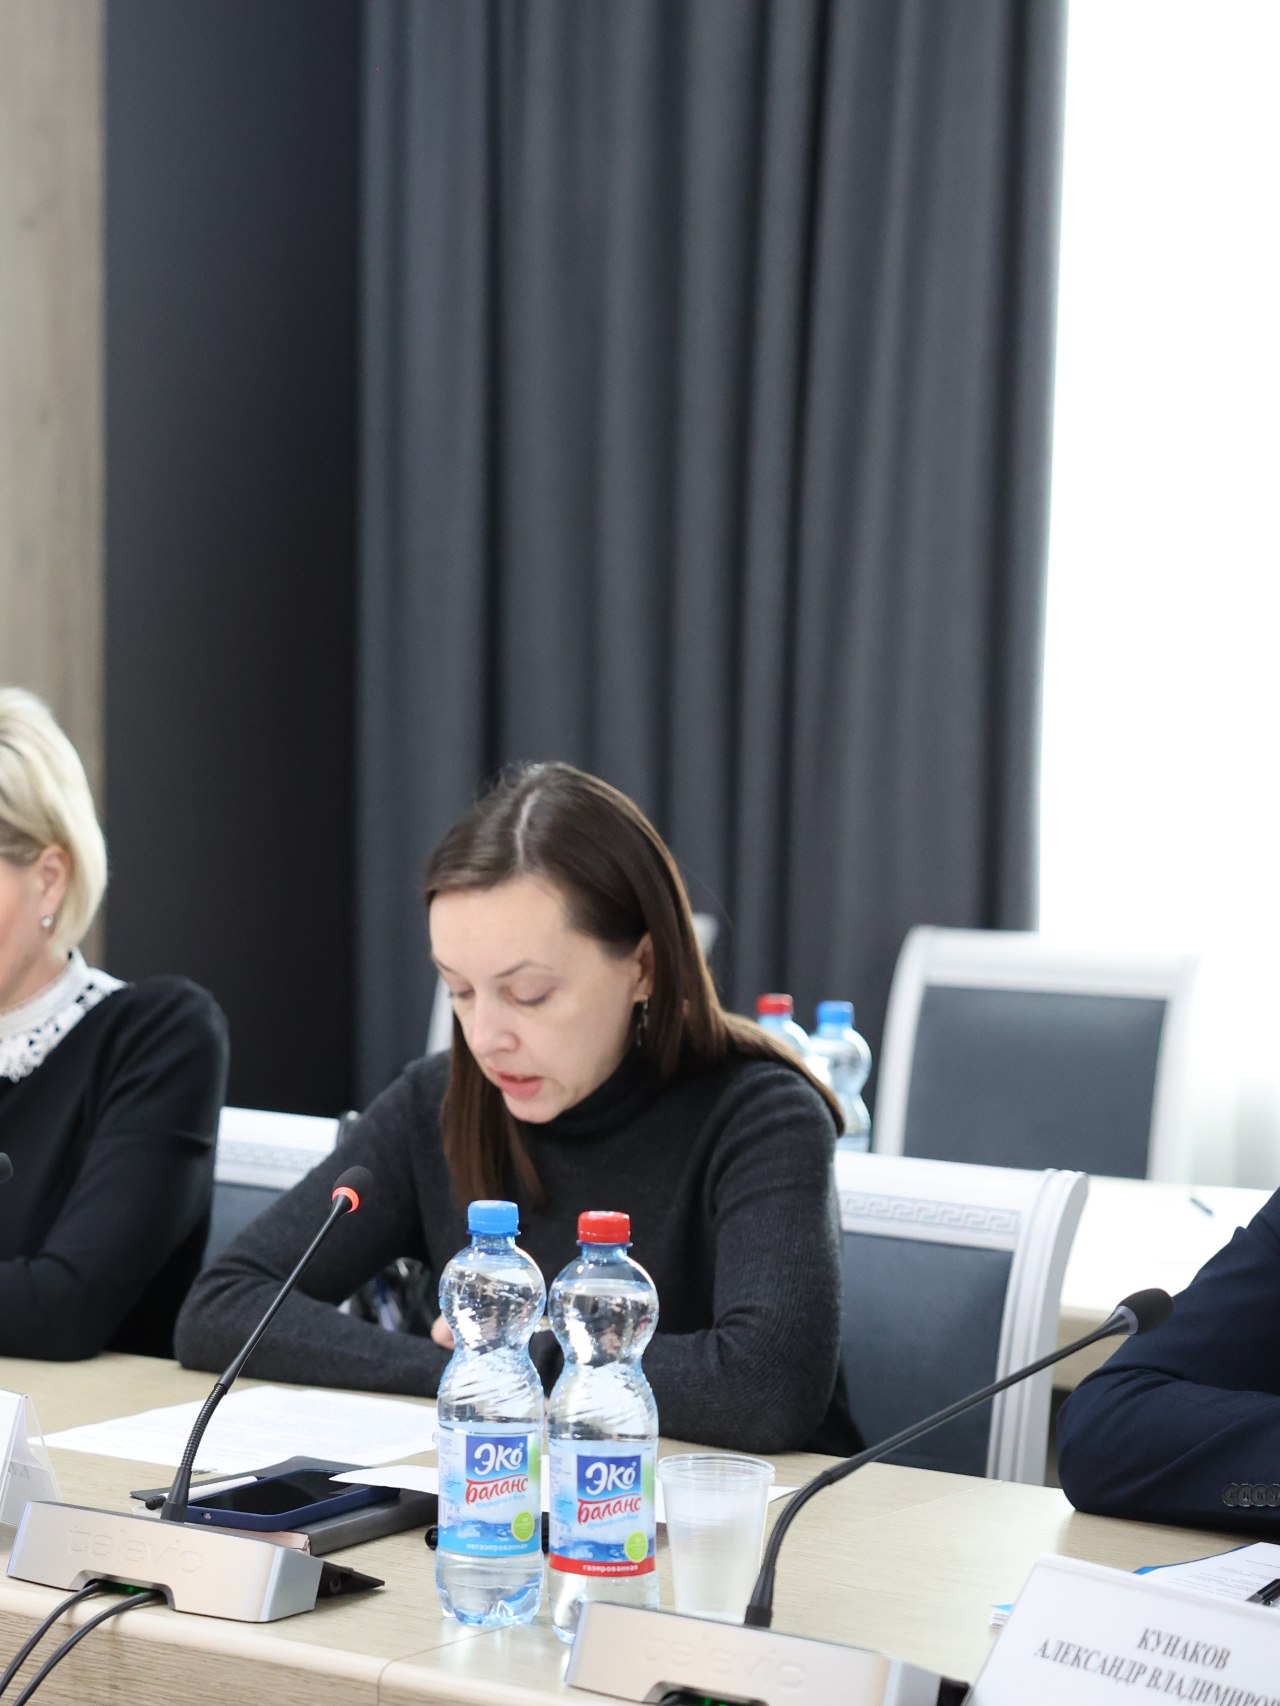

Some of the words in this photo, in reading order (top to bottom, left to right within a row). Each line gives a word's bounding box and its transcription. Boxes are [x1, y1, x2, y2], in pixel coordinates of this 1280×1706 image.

[474, 1442, 524, 1476] Эко
[585, 1461, 637, 1495] Эко
[1137, 1627, 1231, 1671] КУНАКОВ
[1033, 1638, 1147, 1685] АЛЕКСАНДР
[1145, 1665, 1280, 1706] ВЛАДИМИРО
